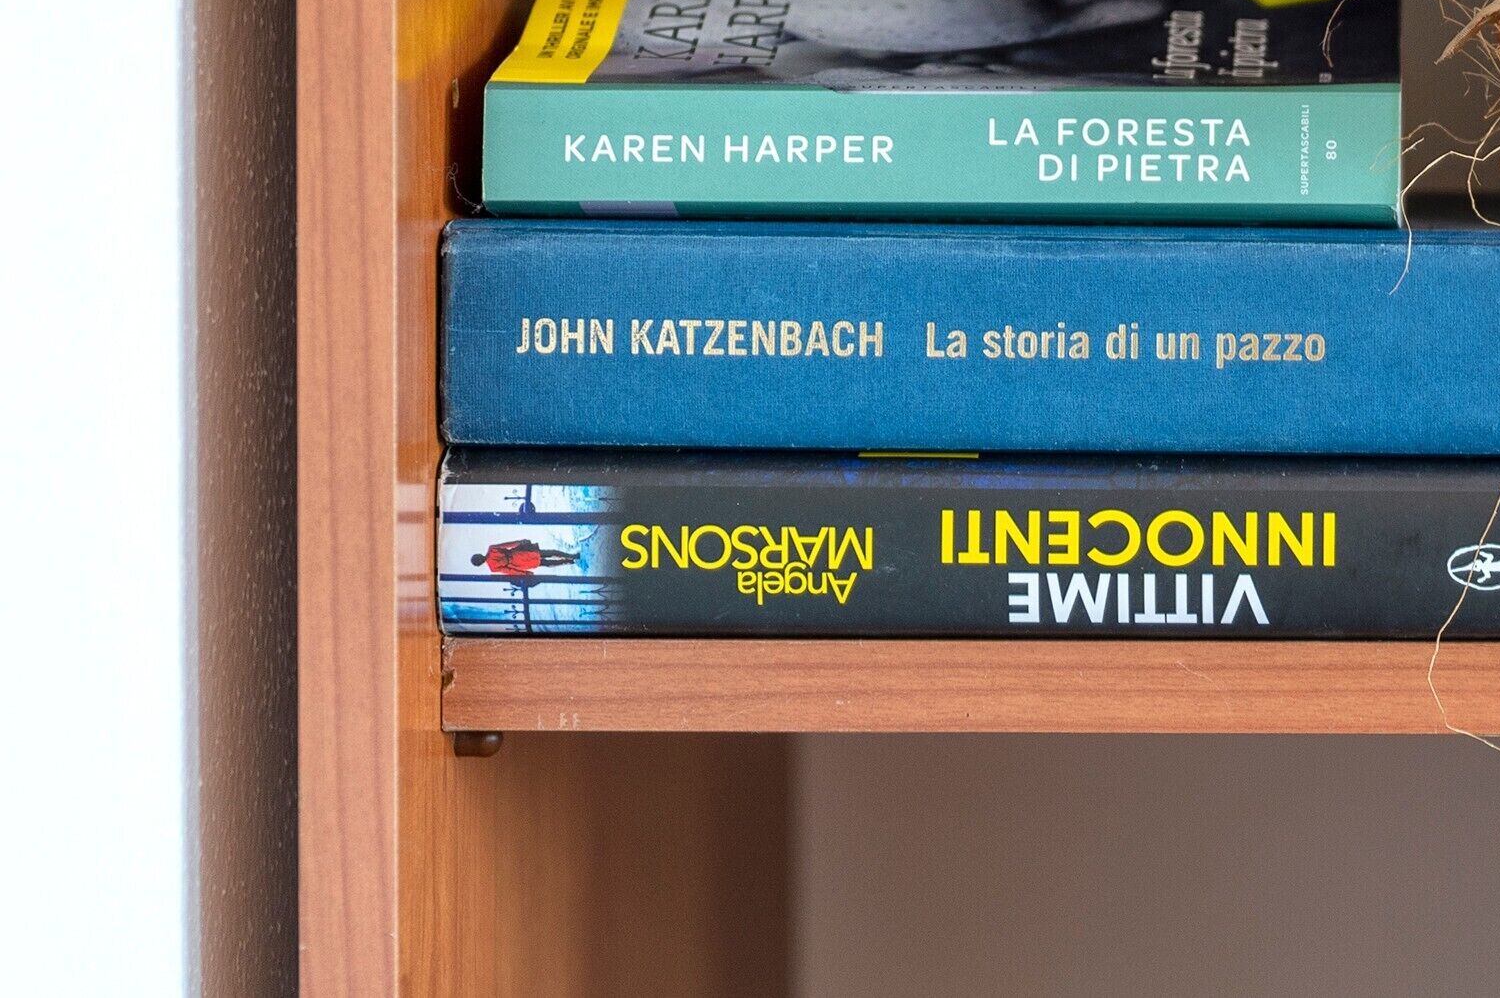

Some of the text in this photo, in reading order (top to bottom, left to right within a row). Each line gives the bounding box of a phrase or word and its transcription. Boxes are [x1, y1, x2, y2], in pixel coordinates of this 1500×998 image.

[1150, 9, 1212, 70] foresta
[1219, 17, 1279, 68] pietra
[564, 134, 894, 164] KAREN HARPER
[988, 117, 1251, 147] LA FORESTA
[1300, 104, 1310, 196] SUPERTASCABILI
[1325, 139, 1338, 161] 80
[1038, 153, 1251, 183] DI PIETRA
[515, 317, 884, 358] JOHN KATZENBACH
[926, 321, 1326, 370] La storia di un pazzo
[620, 524, 874, 571] MARSONS
[941, 509, 1336, 567] INNOCENTI
[736, 561, 859, 605] Angela
[1007, 572, 1270, 625] VITTIME
